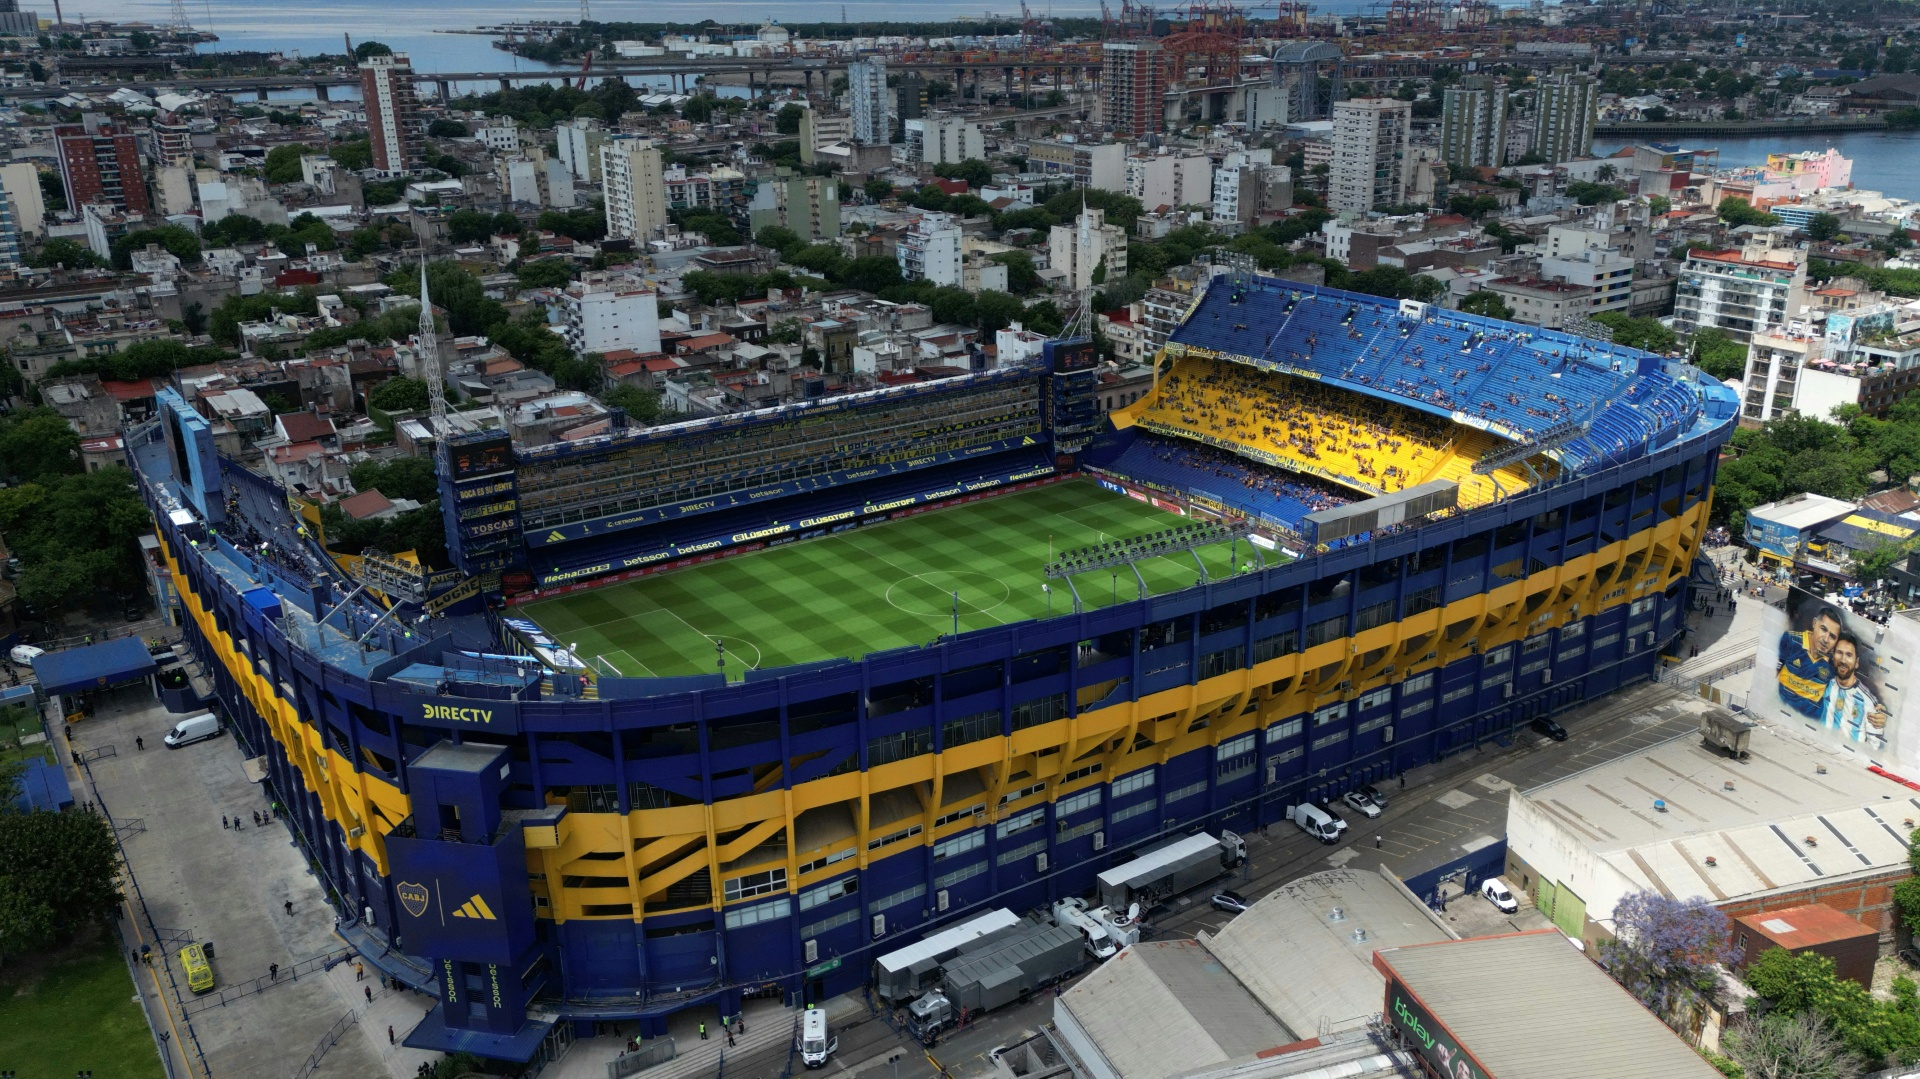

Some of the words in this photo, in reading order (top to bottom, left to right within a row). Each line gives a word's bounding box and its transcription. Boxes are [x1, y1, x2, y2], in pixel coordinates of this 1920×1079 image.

[803, 404, 840, 415] BOMBONERA
[906, 456, 936, 467] DIRECTV
[846, 469, 878, 479] betsson
[460, 489, 476, 499] BOCA
[477, 487, 484, 496] ES
[485, 485, 493, 494] SU
[493, 482, 513, 492] GENTE
[966, 478, 1001, 491] betsson
[1101, 480, 1118, 491] YPF
[749, 487, 784, 499] betsson
[924, 487, 961, 500] betsson
[679, 501, 715, 513] DIRECTV
[472, 519, 515, 535] TOSCAS
[677, 540, 722, 554] betsson
[623, 551, 670, 566] betsson
[422, 703, 493, 723] DIRECTV
[401, 892, 425, 902] CABJ
[743, 986, 754, 995] 20
